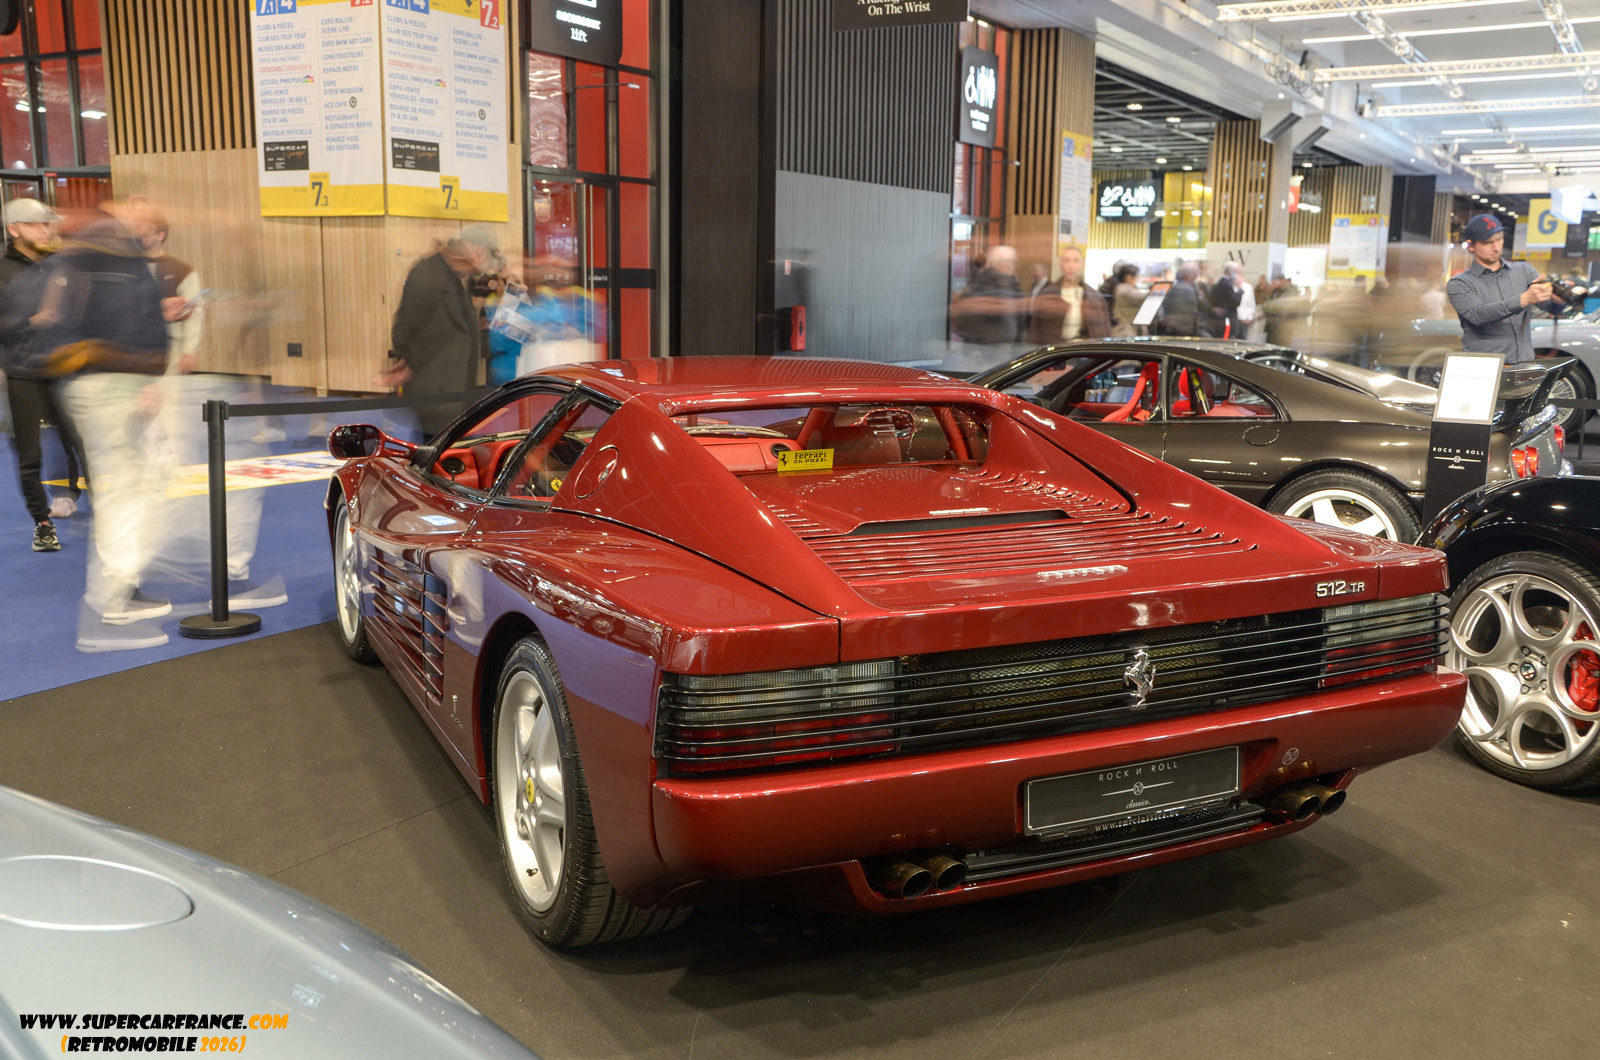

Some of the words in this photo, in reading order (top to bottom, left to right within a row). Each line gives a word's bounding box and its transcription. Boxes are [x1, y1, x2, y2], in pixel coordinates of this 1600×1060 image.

[482, 0, 498, 28] 7.2
[868, 5, 882, 16] On
[884, 4, 903, 14] The
[905, 2, 931, 13] Wrist
[393, 143, 437, 152] SUPERCAR
[312, 182, 328, 206] 7.3
[442, 185, 458, 209] 7.3
[1538, 210, 1558, 234] G
[1316, 581, 1346, 597] 512
[1350, 582, 1364, 592] TR
[1099, 770, 1129, 781] ROCK
[1151, 762, 1177, 772] ROLL
